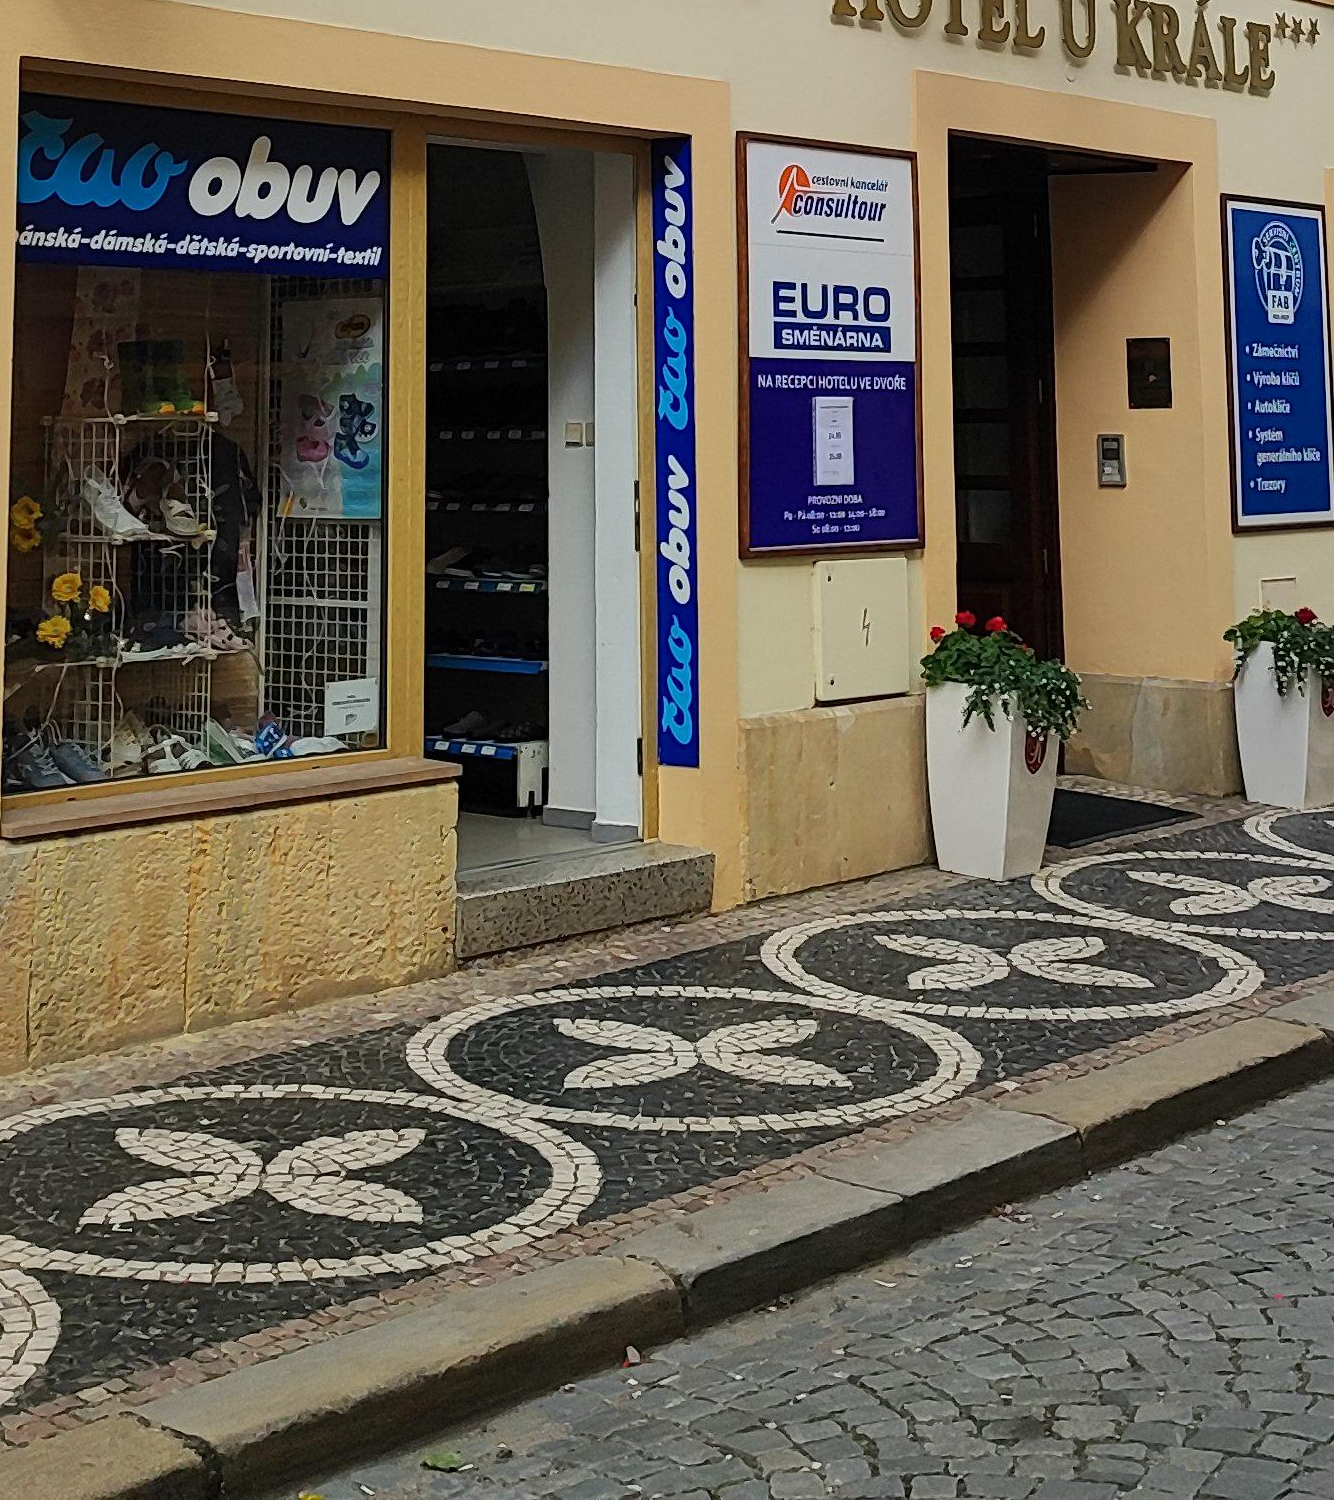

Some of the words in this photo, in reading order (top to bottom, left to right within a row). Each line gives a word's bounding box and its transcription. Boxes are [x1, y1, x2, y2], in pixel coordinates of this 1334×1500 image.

[188, 135, 381, 226] obuv
[811, 174, 849, 189] cestovní
[850, 176, 889, 193] kancelář
[792, 193, 887, 222] consultour
[656, 155, 687, 299] obuv
[772, 280, 891, 323] EURO
[1272, 294, 1290, 310] FAB
[781, 326, 885, 349] SMĚNÁRNA
[1252, 343, 1299, 359] Zámečnictví
[757, 374, 773, 389] NA
[775, 374, 816, 390] RECEPCI
[818, 375, 858, 390] HOTELU
[859, 376, 872, 390] VE
[873, 373, 907, 391] DVOŘE
[1253, 371, 1280, 389] Výroba
[1255, 427, 1283, 444] Systém
[660, 454, 691, 605] obuv
